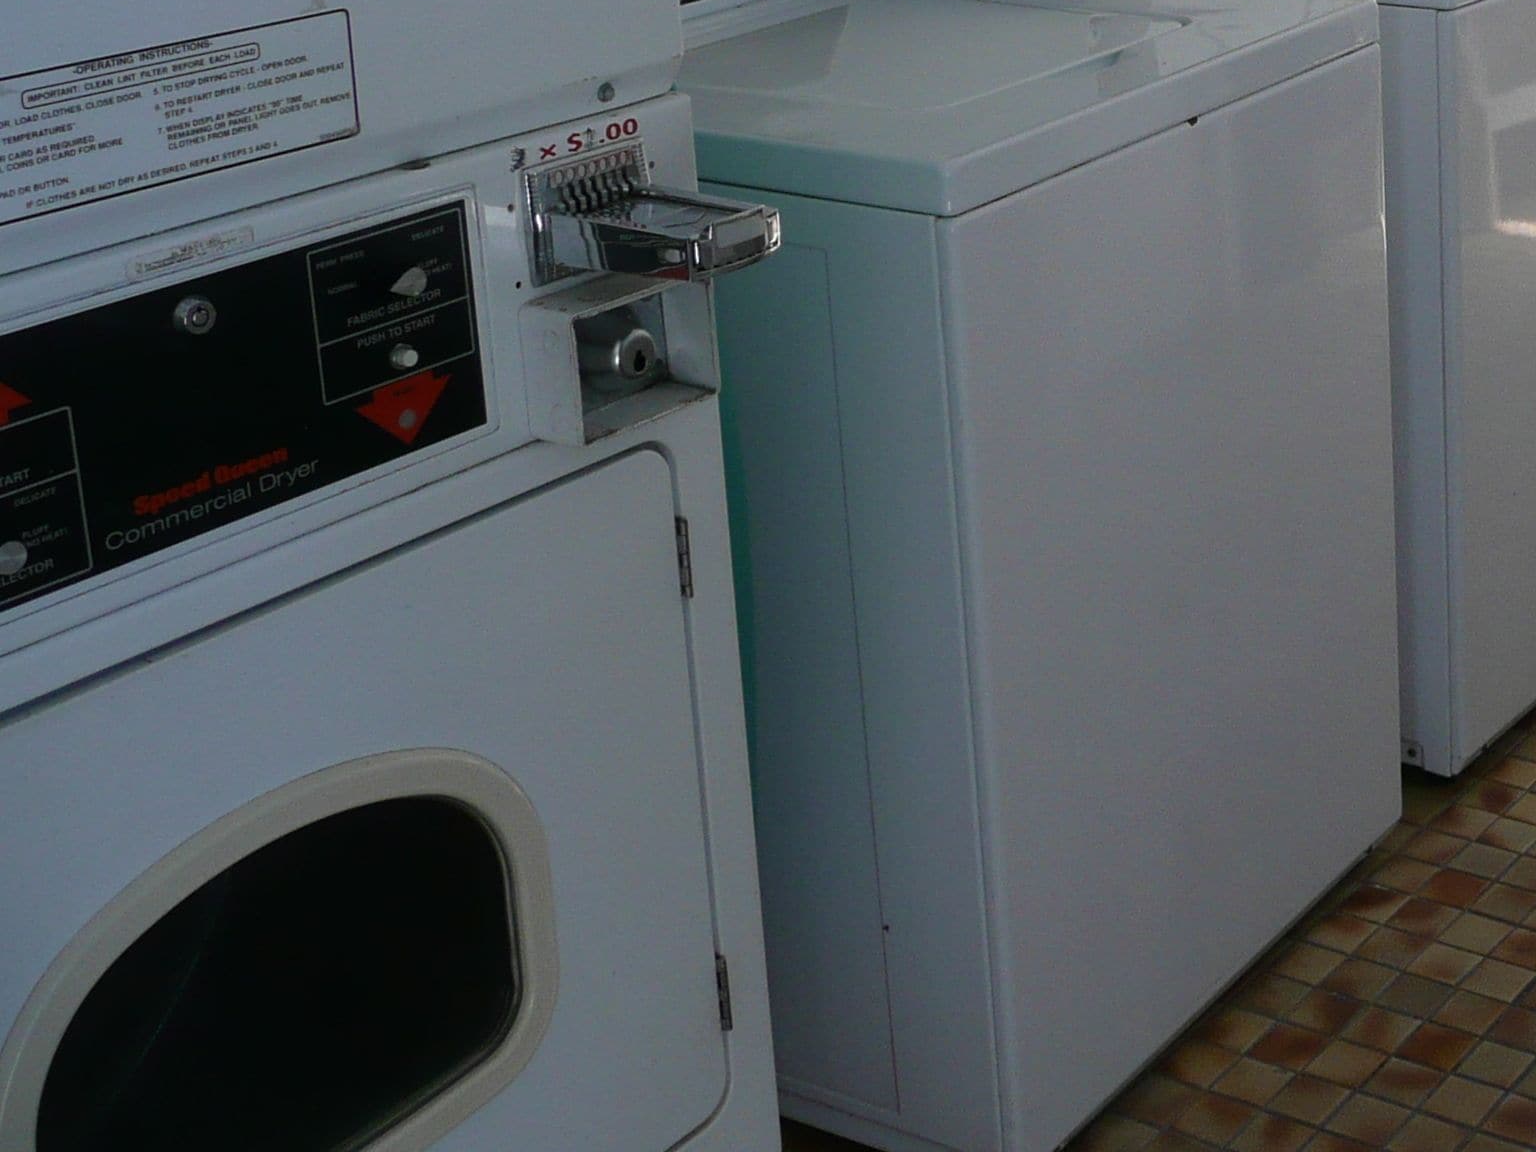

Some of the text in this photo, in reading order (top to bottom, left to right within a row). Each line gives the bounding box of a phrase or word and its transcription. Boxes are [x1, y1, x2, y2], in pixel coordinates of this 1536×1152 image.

[84, 79, 113, 91] CLEAN
[140, 66, 168, 79] FILTER
[172, 59, 204, 72] BEFORE
[209, 54, 231, 65] EACH
[234, 48, 256, 59] LOAD
[198, 73, 228, 86] DRYING
[229, 66, 255, 79] CYCLE
[214, 85, 241, 98] DRYER
[14, 114, 39, 126] LOAD
[85, 98, 115, 111] CLOSE
[8, 149, 34, 161] CARD
[36, 145, 48, 154] AS
[50, 135, 95, 151] REQUIRED
[52, 149, 76, 161] CARD
[78, 143, 96, 155] FOR
[33, 177, 69, 192] BUTTON
[36, 189, 77, 207] CLOTHES
[79, 184, 97, 196] ARE
[98, 179, 116, 191] NOT
[117, 175, 135, 187] DRY
[347, 288, 441, 328] FABRIC SELECTOR
[357, 313, 435, 348] PUSH TO START
[105, 459, 319, 550] Commercial Dryer
